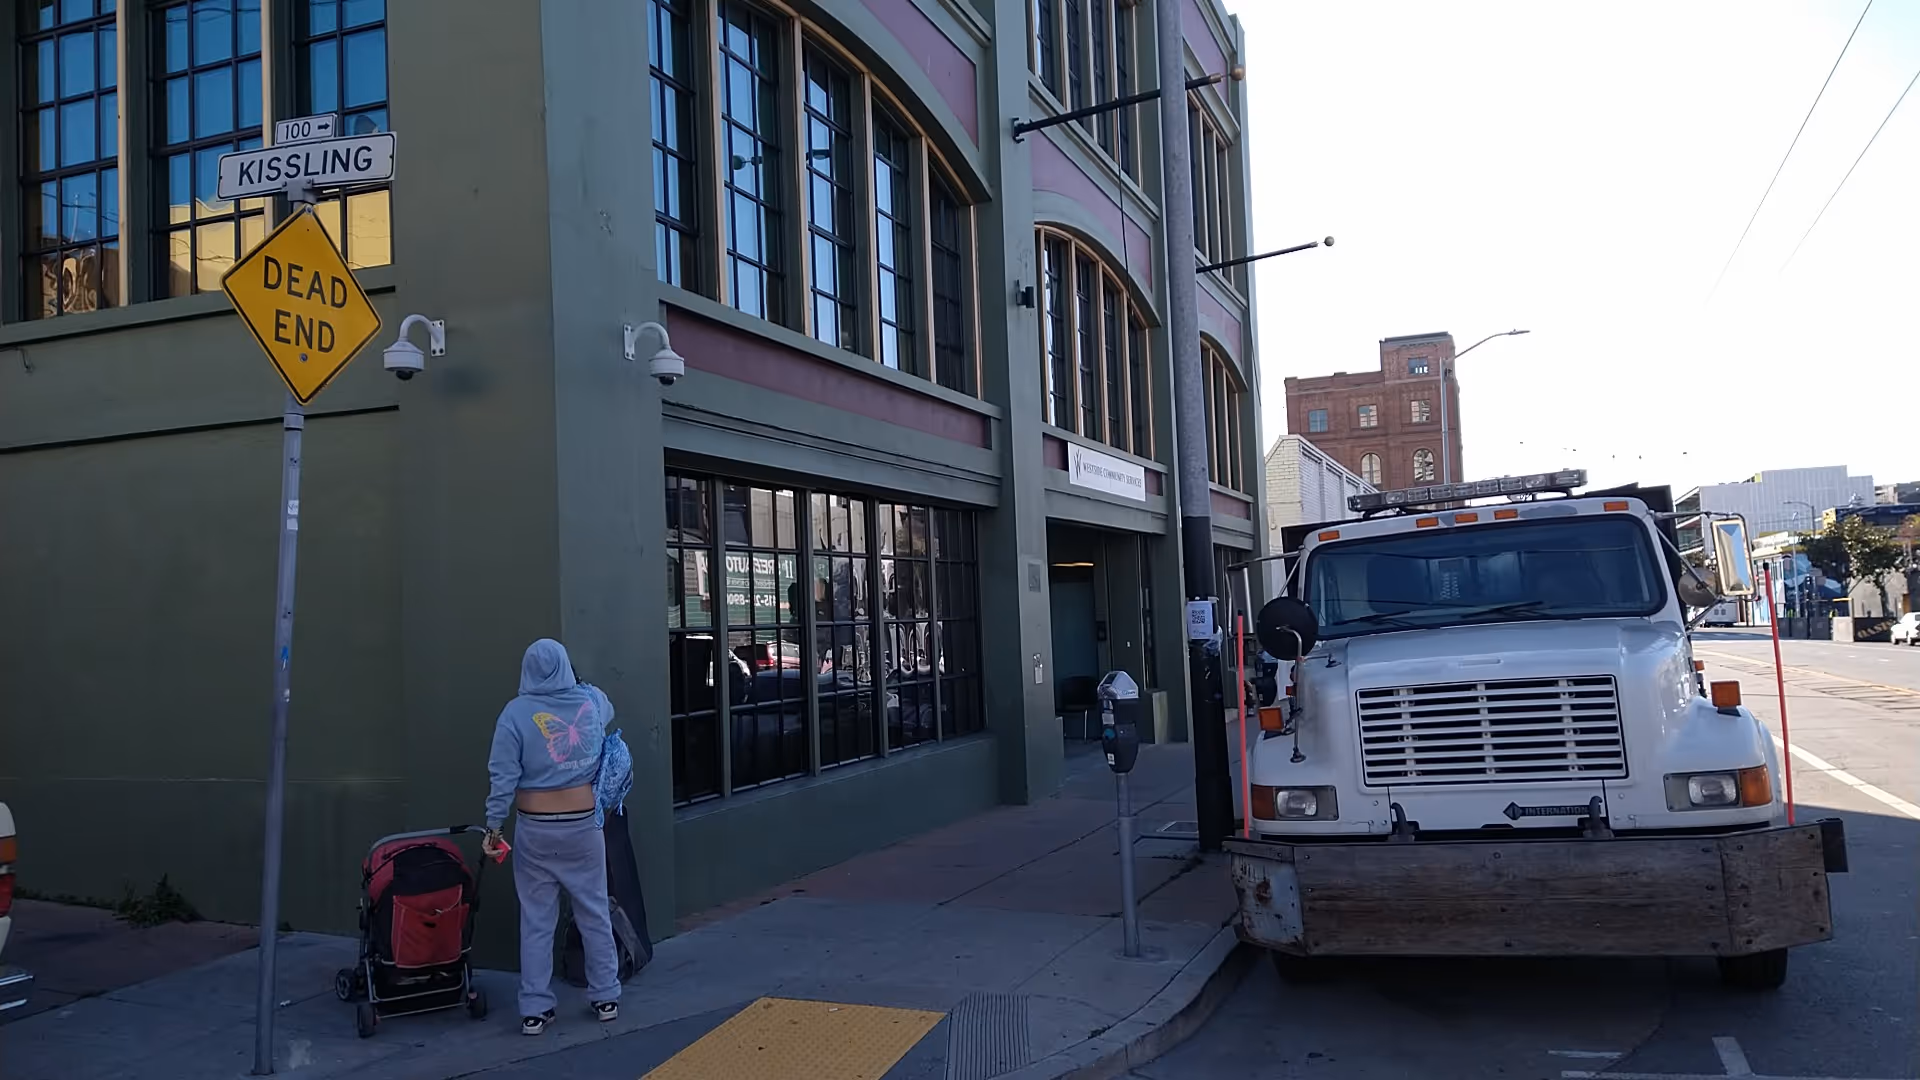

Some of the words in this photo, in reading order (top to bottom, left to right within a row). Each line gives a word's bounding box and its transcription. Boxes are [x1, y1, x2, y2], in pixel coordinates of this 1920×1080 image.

[285, 121, 311, 140] 100
[238, 145, 372, 186] KISSLING
[263, 255, 348, 309] DEAD
[274, 308, 335, 353] END
[1525, 806, 1590, 816] INTERNATION
